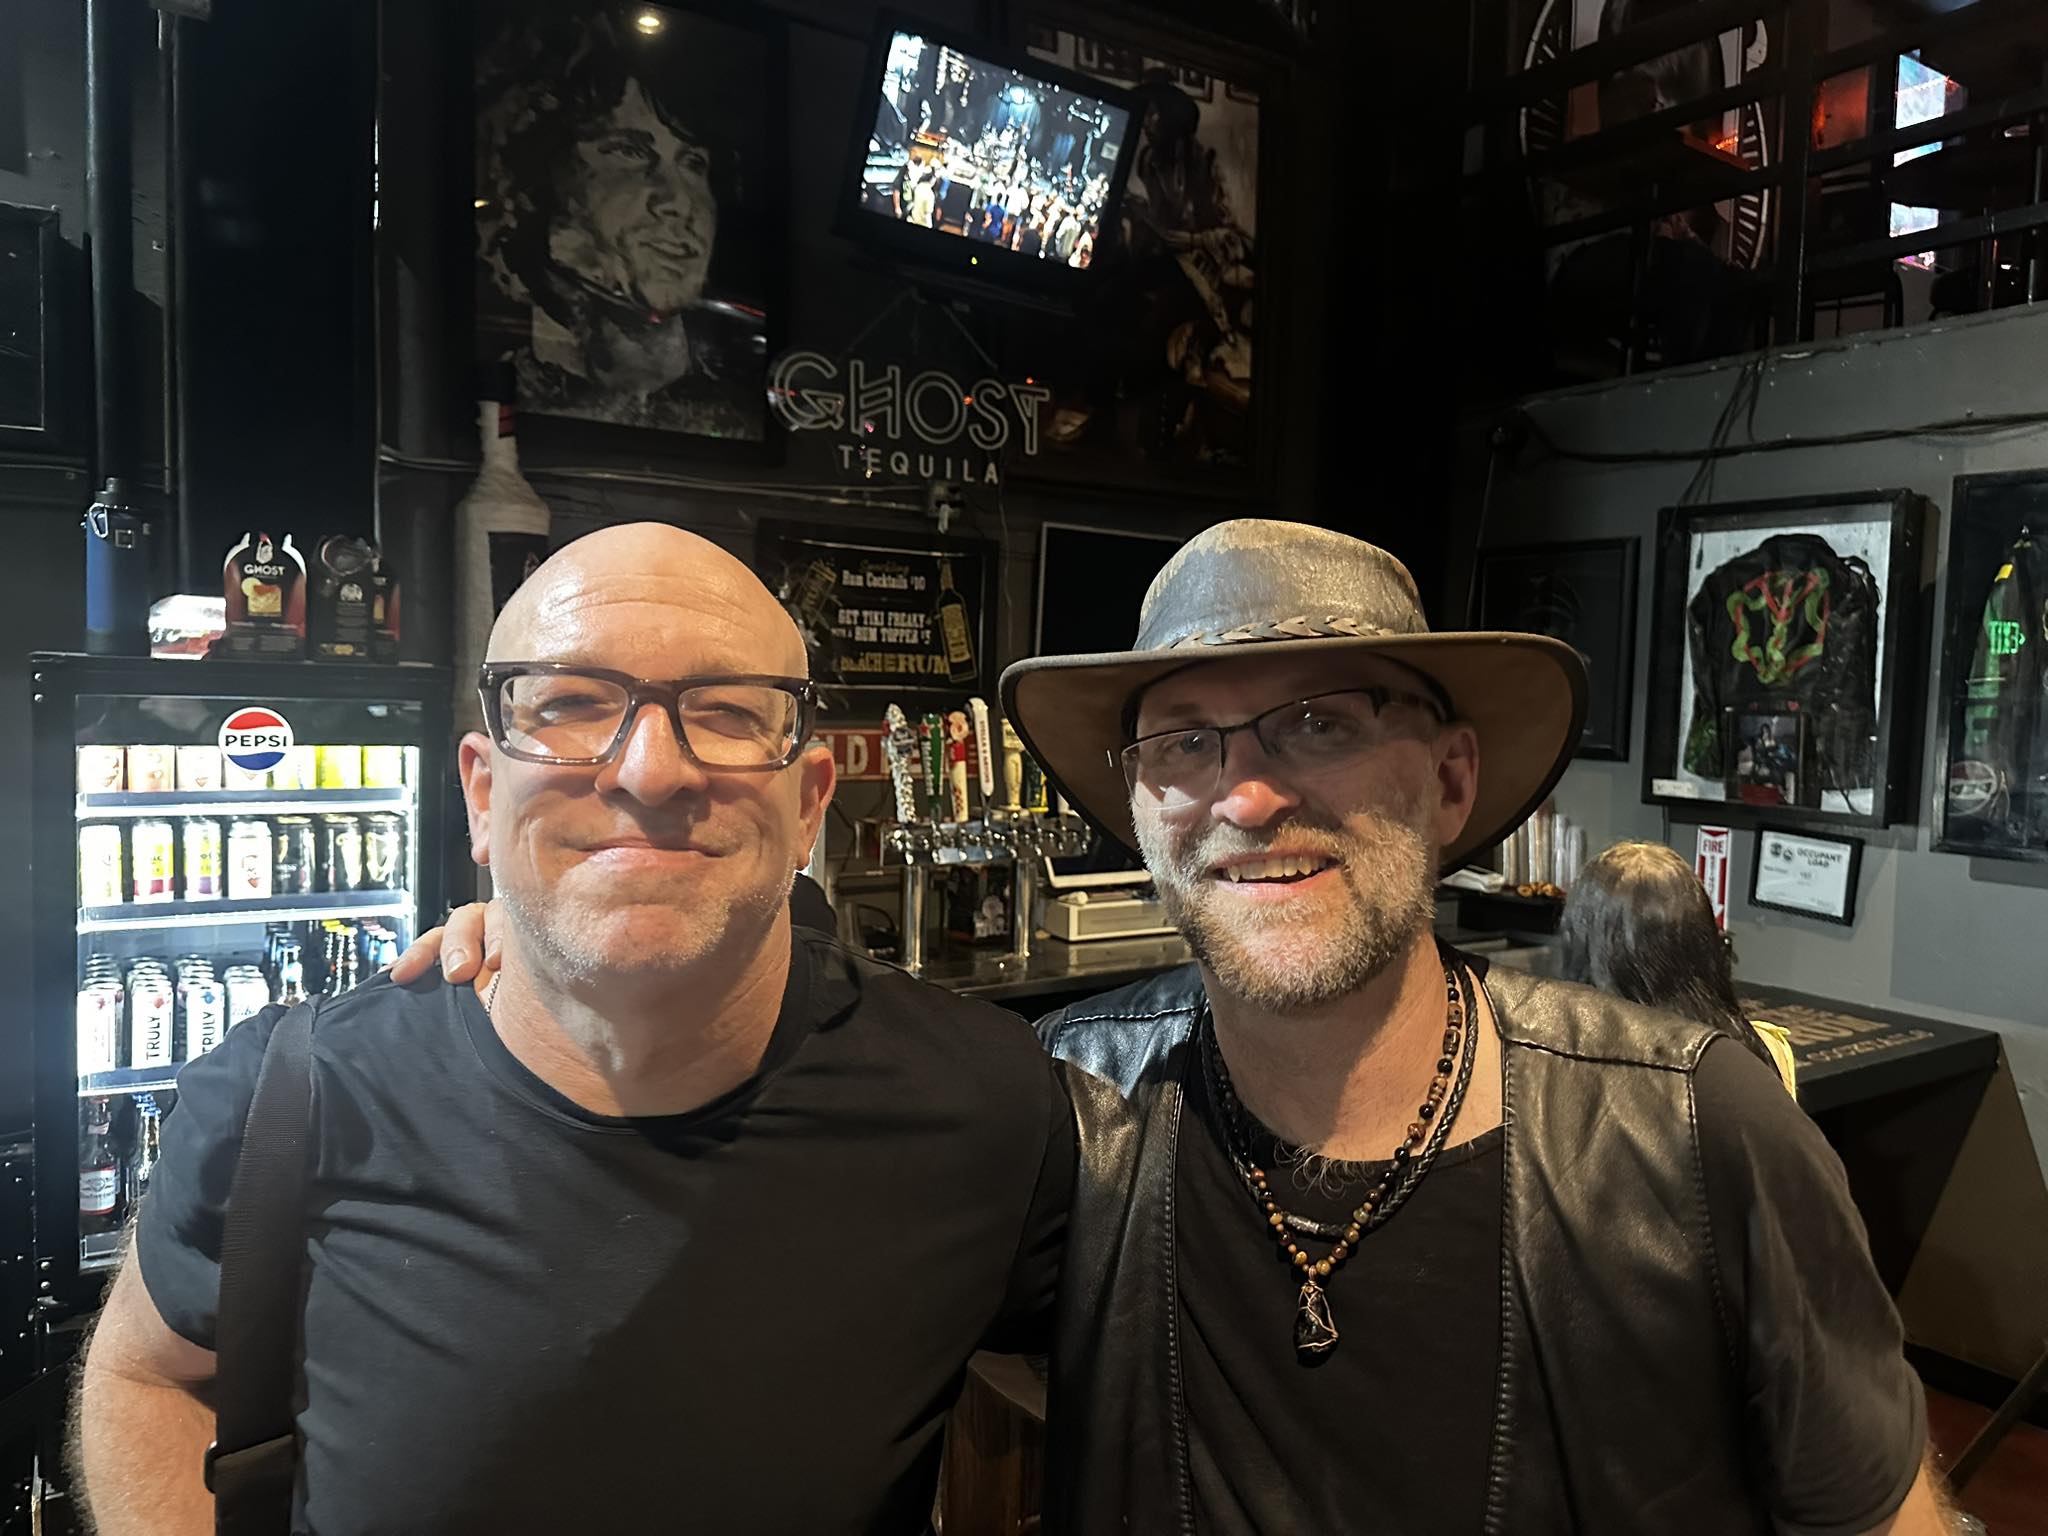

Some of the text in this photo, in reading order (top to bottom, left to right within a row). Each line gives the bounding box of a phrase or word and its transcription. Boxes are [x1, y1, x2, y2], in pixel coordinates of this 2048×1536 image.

[773, 351, 1050, 455] GHOST
[838, 445, 998, 485] TEQUILA
[244, 563, 286, 577] GHOST
[224, 733, 289, 749] PEPSI
[1702, 838, 1725, 855] FIRE
[1796, 846, 1843, 864] OCCUPANT
[1807, 857, 1830, 868] LOAD
[145, 1015, 161, 1061] TRULY
[201, 1011, 215, 1054] TRULY
